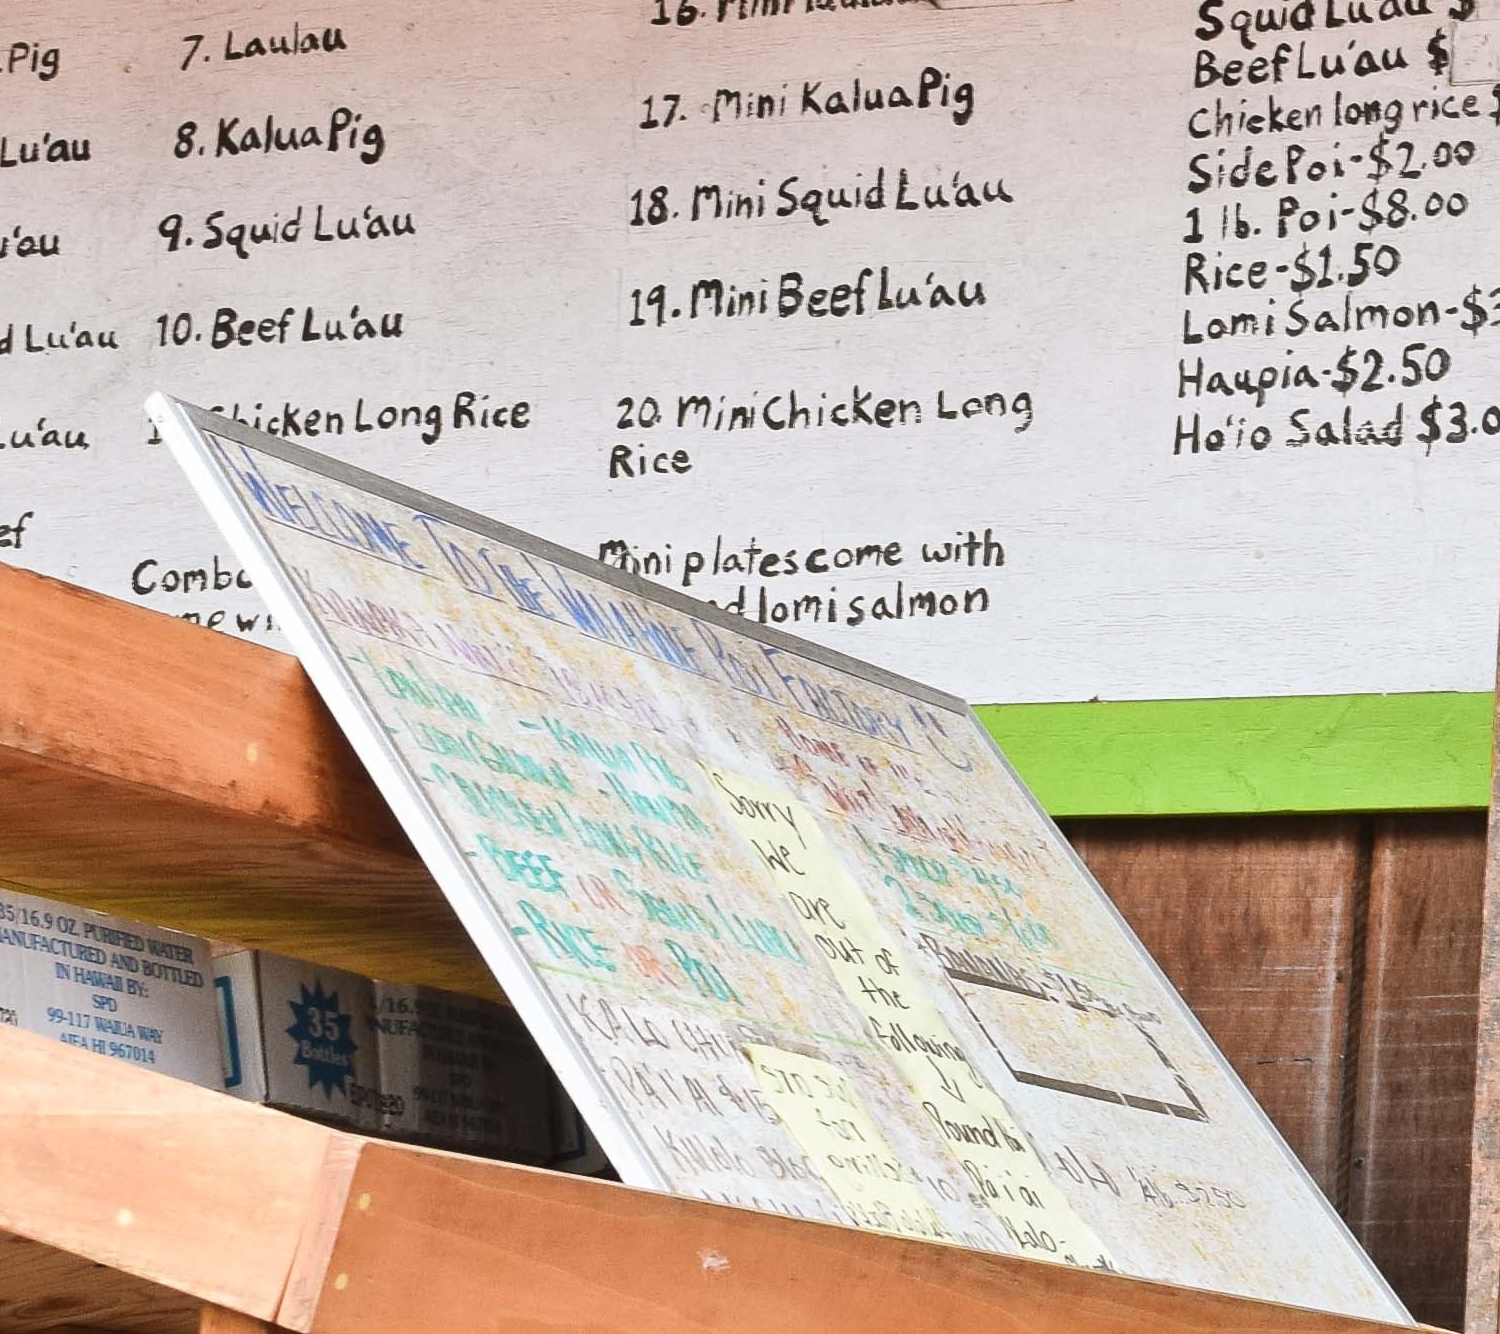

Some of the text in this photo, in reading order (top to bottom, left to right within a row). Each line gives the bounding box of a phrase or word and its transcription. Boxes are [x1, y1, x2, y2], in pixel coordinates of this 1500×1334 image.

[8, 41, 60, 82] Pig
[180, 22, 348, 72] 7. Laulau
[1194, 36, 1293, 89] Beef
[639, 66, 974, 130] 17. Mini Kalua Pig
[1334, 90, 1404, 141] long
[1412, 86, 1481, 123] rice
[173, 106, 386, 165] 8. Kalua Pig
[1187, 145, 1278, 195] Side
[629, 185, 679, 227] 18.
[690, 178, 765, 222] Mini
[775, 166, 886, 227] Squid
[157, 213, 193, 253] 9.
[202, 205, 303, 260] Squid
[1182, 206, 1204, 244] 1
[629, 284, 681, 328] 19.
[689, 278, 768, 319] Mini
[777, 267, 874, 319] Beef
[1182, 297, 1276, 345] Lomi
[156, 312, 202, 347] 10.
[210, 307, 296, 350] Beef
[354, 391, 530, 446] Long Rice
[677, 395, 756, 432] Mini
[762, 385, 922, 431] Chicken
[937, 390, 1033, 434] Long
[1285, 402, 1404, 448] Salad
[609, 444, 693, 479] Rice
[600, 528, 1005, 588] Mini plates come with
[753, 585, 837, 630] lomi
[846, 580, 990, 627] salmon
[711, 771, 807, 850] Sorry
[787, 890, 846, 930] are
[111, 952, 140, 973] AND
[141, 957, 204, 988] BOTTLED
[149, 938, 193, 965] WATER
[813, 933, 900, 976] out of
[56, 963, 71, 979] IN
[75, 965, 124, 991] HAWAII
[856, 975, 910, 1010] the
[92, 995, 116, 1012] SPD
[308, 1007, 340, 1040] 35
[867, 1014, 983, 1089] following
[921, 1100, 1002, 1148] Pound
